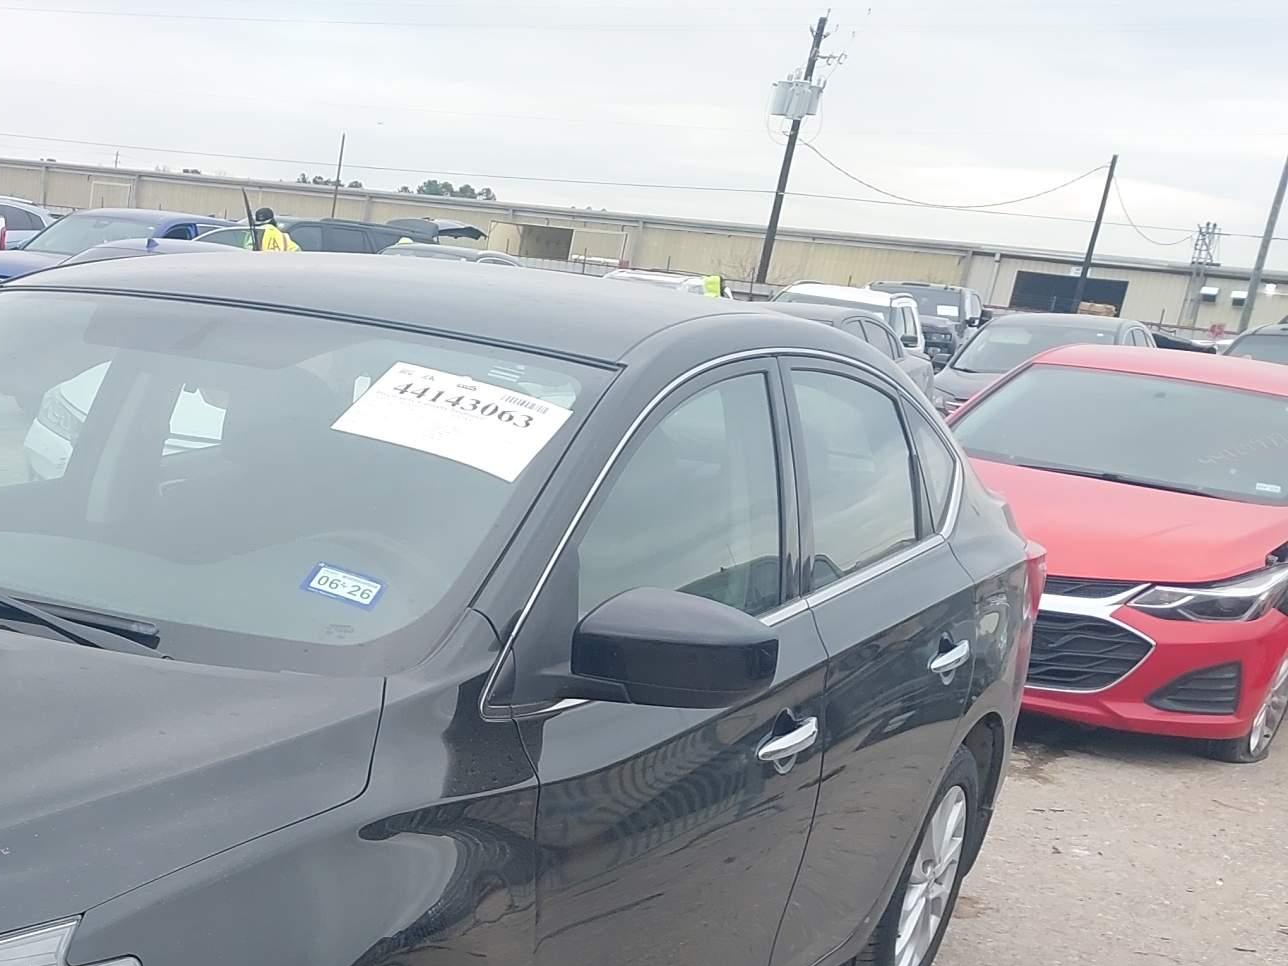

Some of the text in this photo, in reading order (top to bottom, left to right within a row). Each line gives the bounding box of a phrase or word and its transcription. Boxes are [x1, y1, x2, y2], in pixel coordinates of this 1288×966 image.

[393, 382, 534, 428] 44143063
[317, 575, 342, 590] 06
[346, 584, 373, 600] 26
